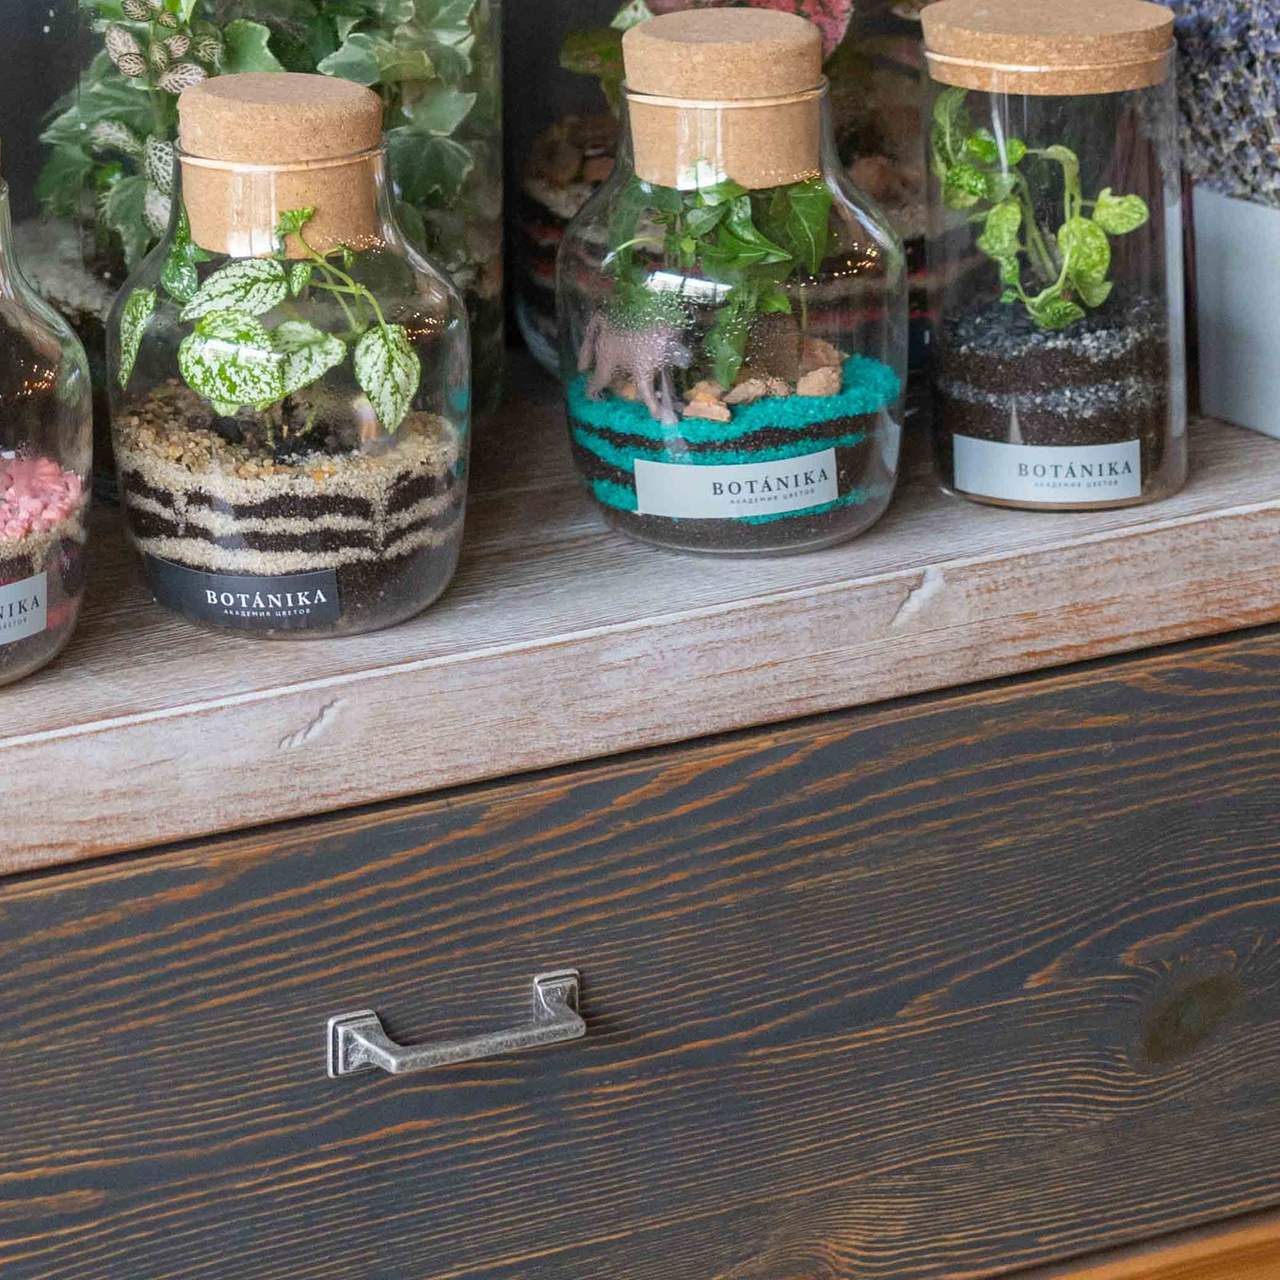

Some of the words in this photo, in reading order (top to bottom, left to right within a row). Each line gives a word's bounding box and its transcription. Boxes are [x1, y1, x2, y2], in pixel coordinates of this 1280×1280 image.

[1018, 460, 1132, 479] BOTÁNIKA
[712, 468, 829, 496] BOTÁNIKA
[206, 589, 327, 608] BOTÁNIKA
[224, 608, 271, 617] АКАДЕМИЯ
[275, 608, 310, 617] ЦВЕТОВ
